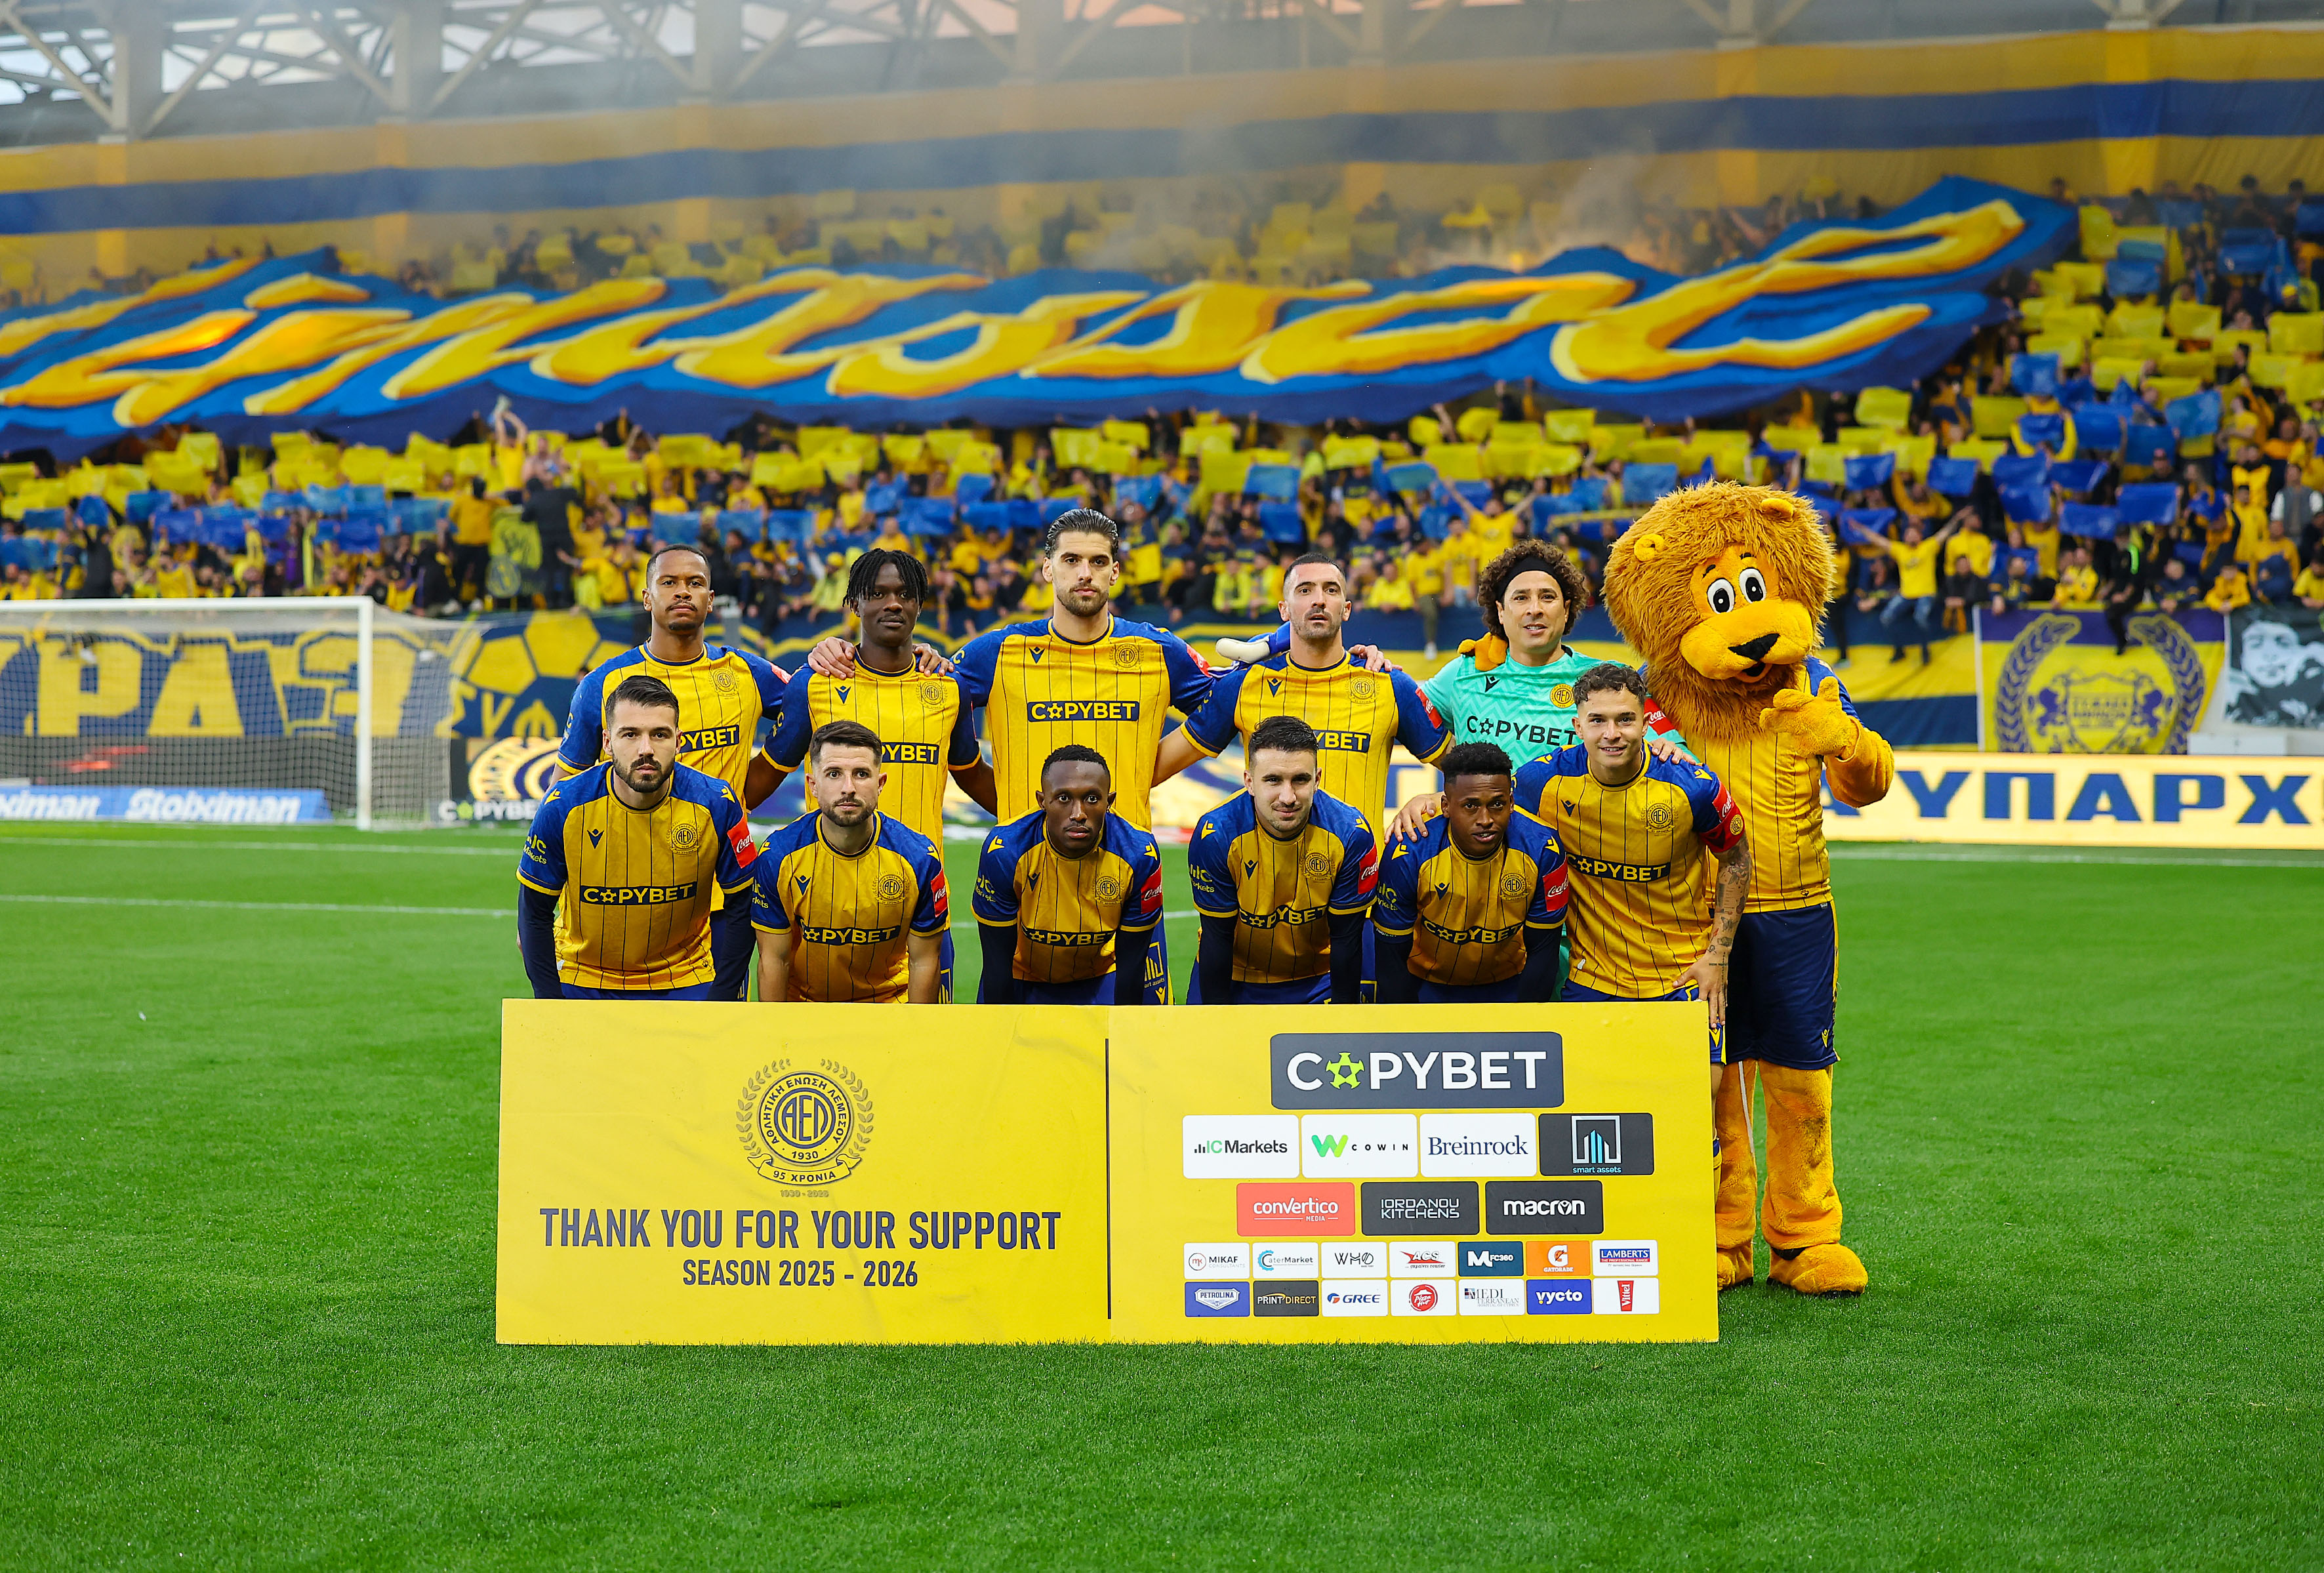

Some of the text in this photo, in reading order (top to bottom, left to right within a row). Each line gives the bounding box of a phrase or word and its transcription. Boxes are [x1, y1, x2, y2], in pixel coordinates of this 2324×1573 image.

[1897, 770, 2324, 825] ΥΠΑΡΧ
[584, 884, 693, 904] COPYBET
[1287, 1051, 1547, 1091] COPYBET
[764, 1077, 847, 1145] ΑΘΛΗΤΙΚΗ ΕΝΩΣΗ ΛΕΜΕΣΟΥ
[1225, 1140, 1288, 1154] Markets
[1429, 1135, 1528, 1154] Breinrock
[792, 1151, 819, 1160] 1930
[773, 1171, 836, 1182] 95 ΧΡΟΝΙΑ
[1254, 1198, 1339, 1214] convertico
[1381, 1208, 1460, 1219] KITCHENS
[1503, 1199, 1585, 1216] macron
[540, 1208, 1061, 1250] THANK YOU FOR YOUR SUPPORT
[1412, 1251, 1440, 1261] ACS
[1601, 1250, 1648, 1258] LAMBERTS
[683, 1259, 769, 1286] SEASON
[779, 1260, 834, 1286] 2025
[864, 1261, 917, 1286] 2026
[1343, 1294, 1381, 1303] GREE
[1414, 1295, 1431, 1303] Pizza
[1621, 1283, 1631, 1307] Vittel
